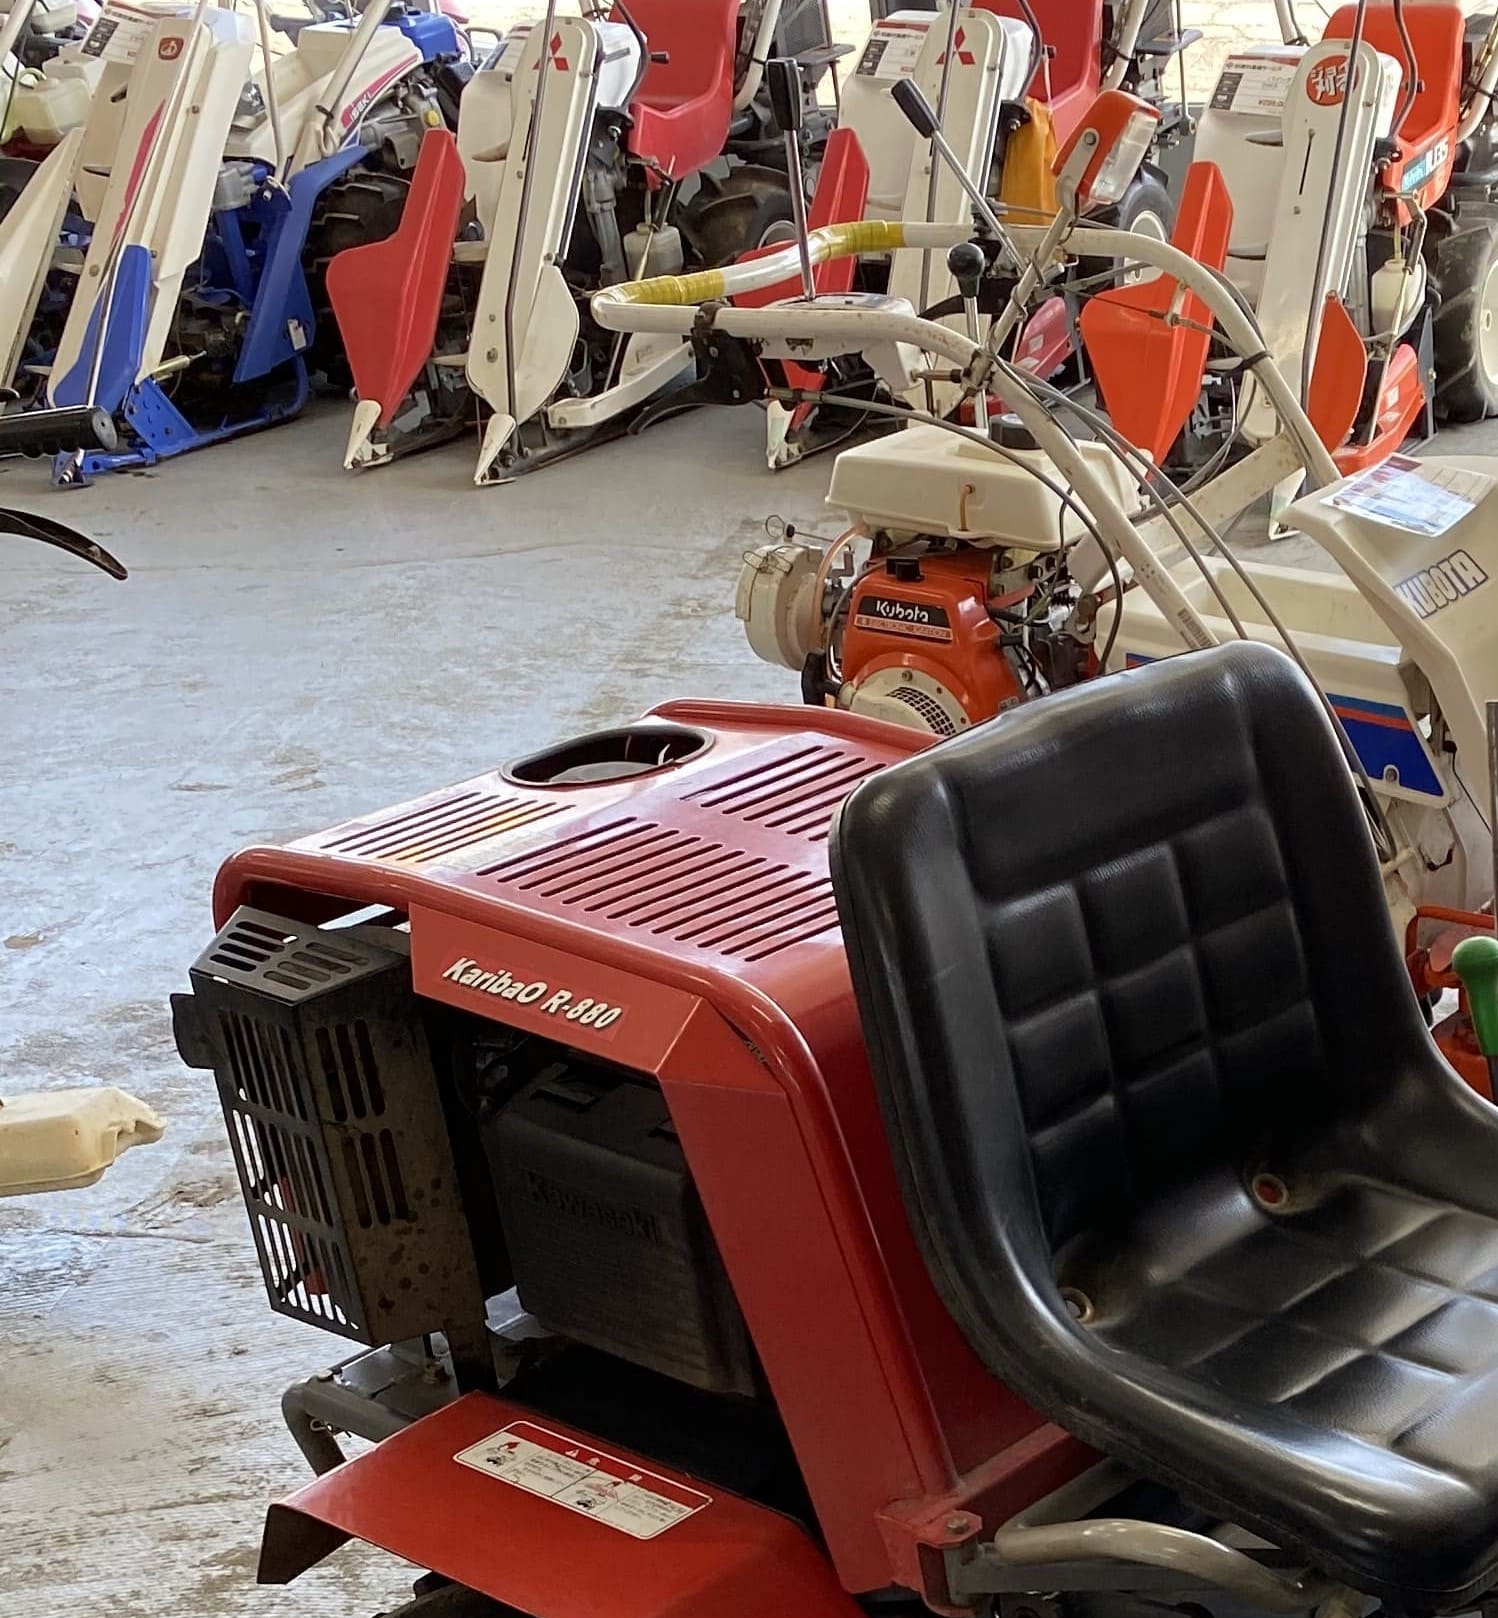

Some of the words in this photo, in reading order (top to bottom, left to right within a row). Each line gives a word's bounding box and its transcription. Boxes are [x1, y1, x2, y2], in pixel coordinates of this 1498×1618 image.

[1392, 548, 1489, 620] KUBOTA
[876, 600, 929, 623] Kubota
[540, 988, 624, 1030] R-880
